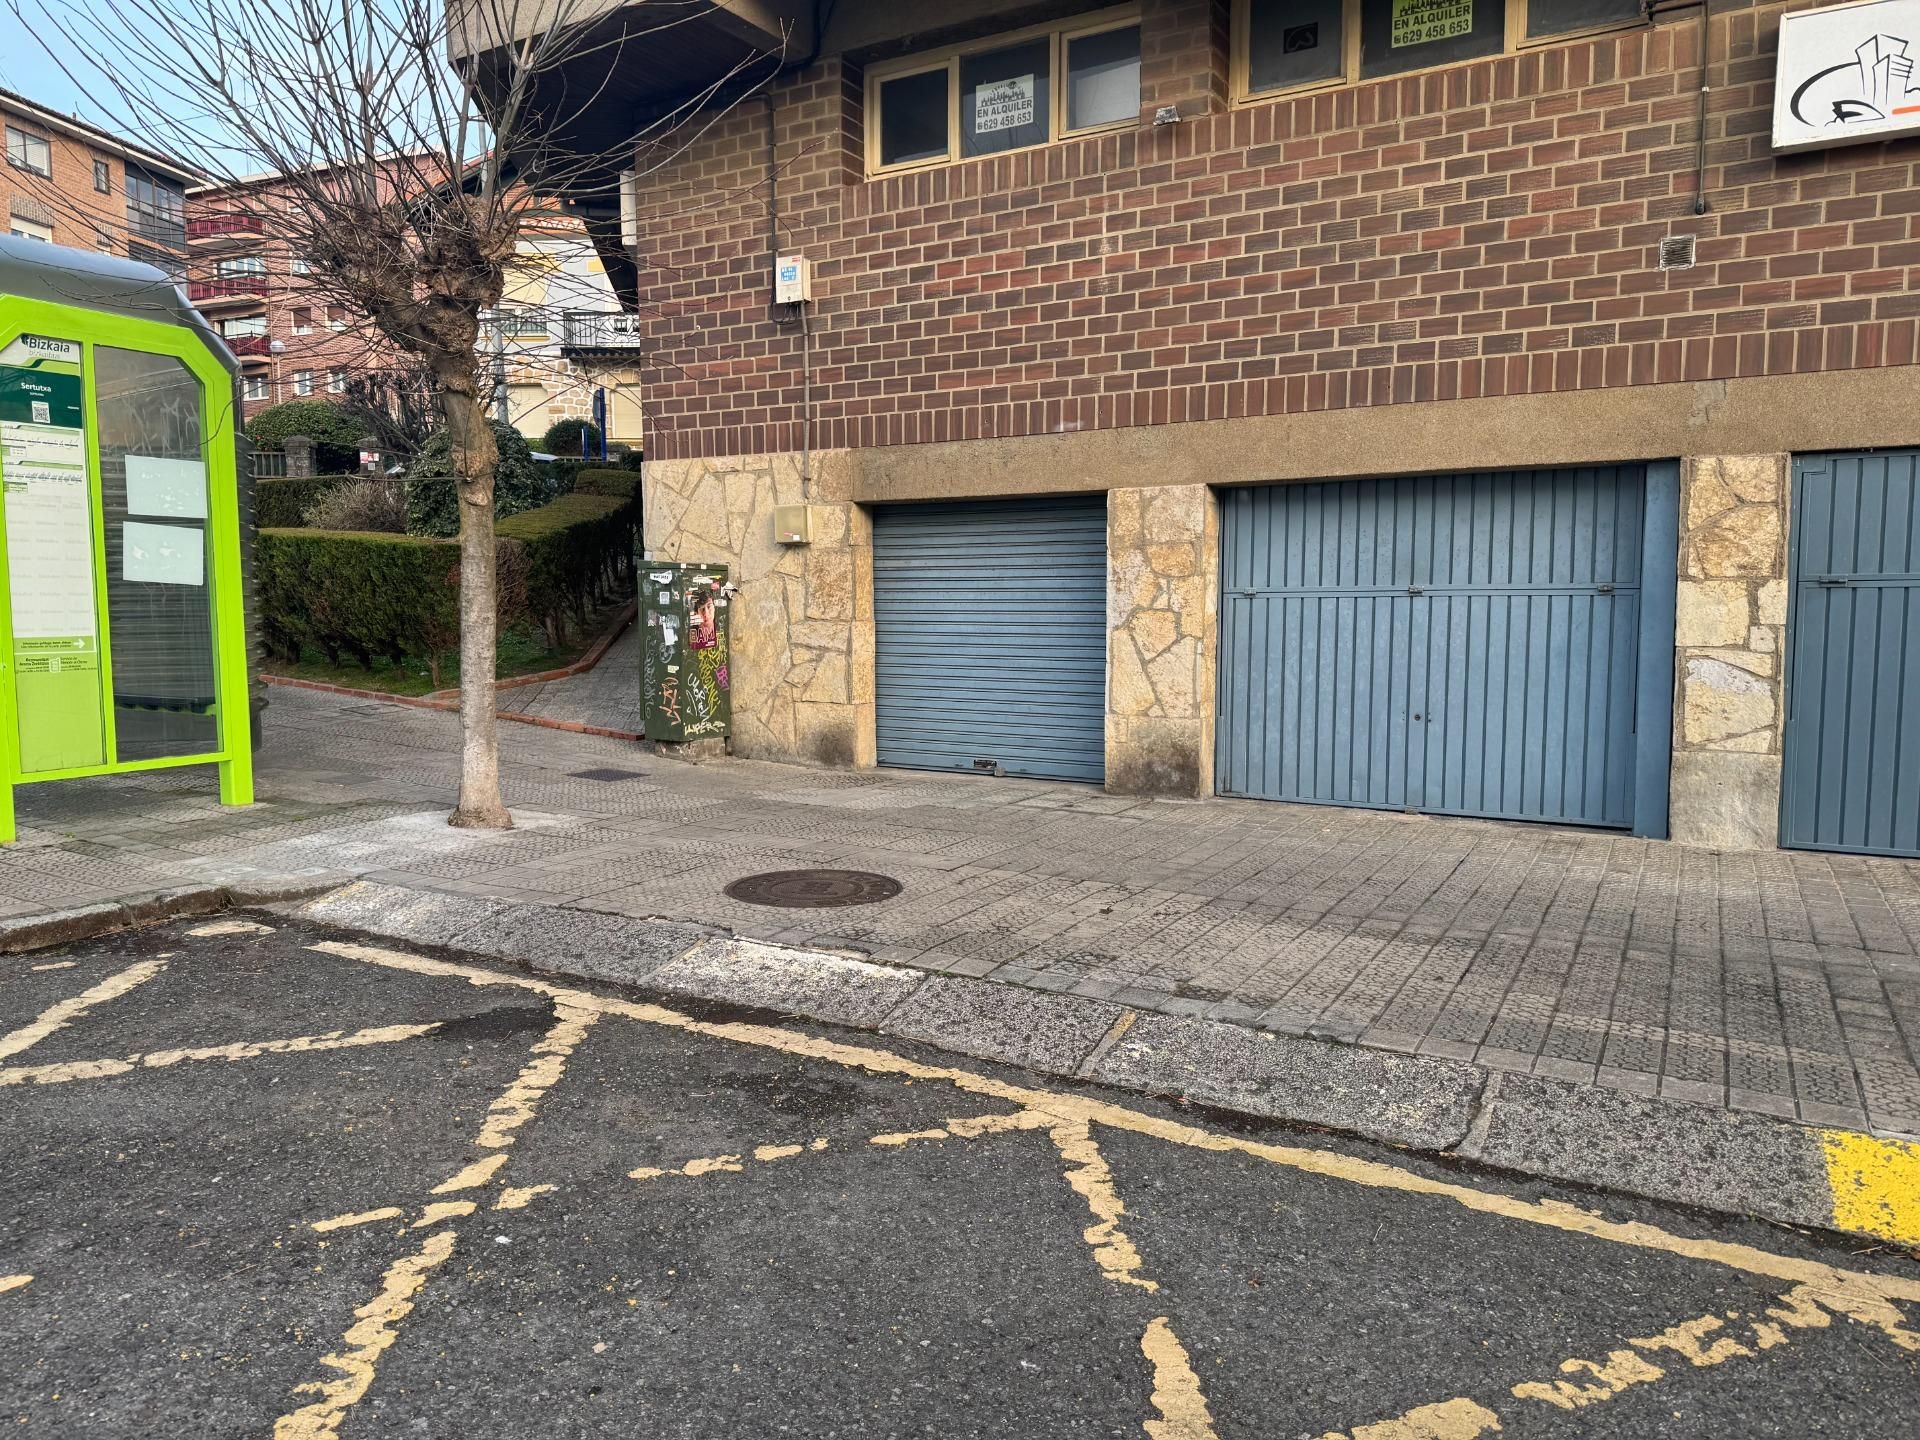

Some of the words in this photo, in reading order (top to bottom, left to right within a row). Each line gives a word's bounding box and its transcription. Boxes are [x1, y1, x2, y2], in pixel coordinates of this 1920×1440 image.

[1394, 17, 1409, 30] EN
[1413, 5, 1470, 26] ALQUILER
[1402, 29, 1422, 44] 629
[1425, 24, 1446, 38] 458
[1449, 19, 1469, 34] 653
[977, 106, 989, 118] EN
[991, 99, 1032, 115] ALQUILER
[983, 118, 998, 131] 629
[1000, 114, 1015, 127] 458
[1017, 111, 1032, 124] 653
[29, 337, 70, 353] Bizkaia
[20, 382, 52, 393] Sertutxa
